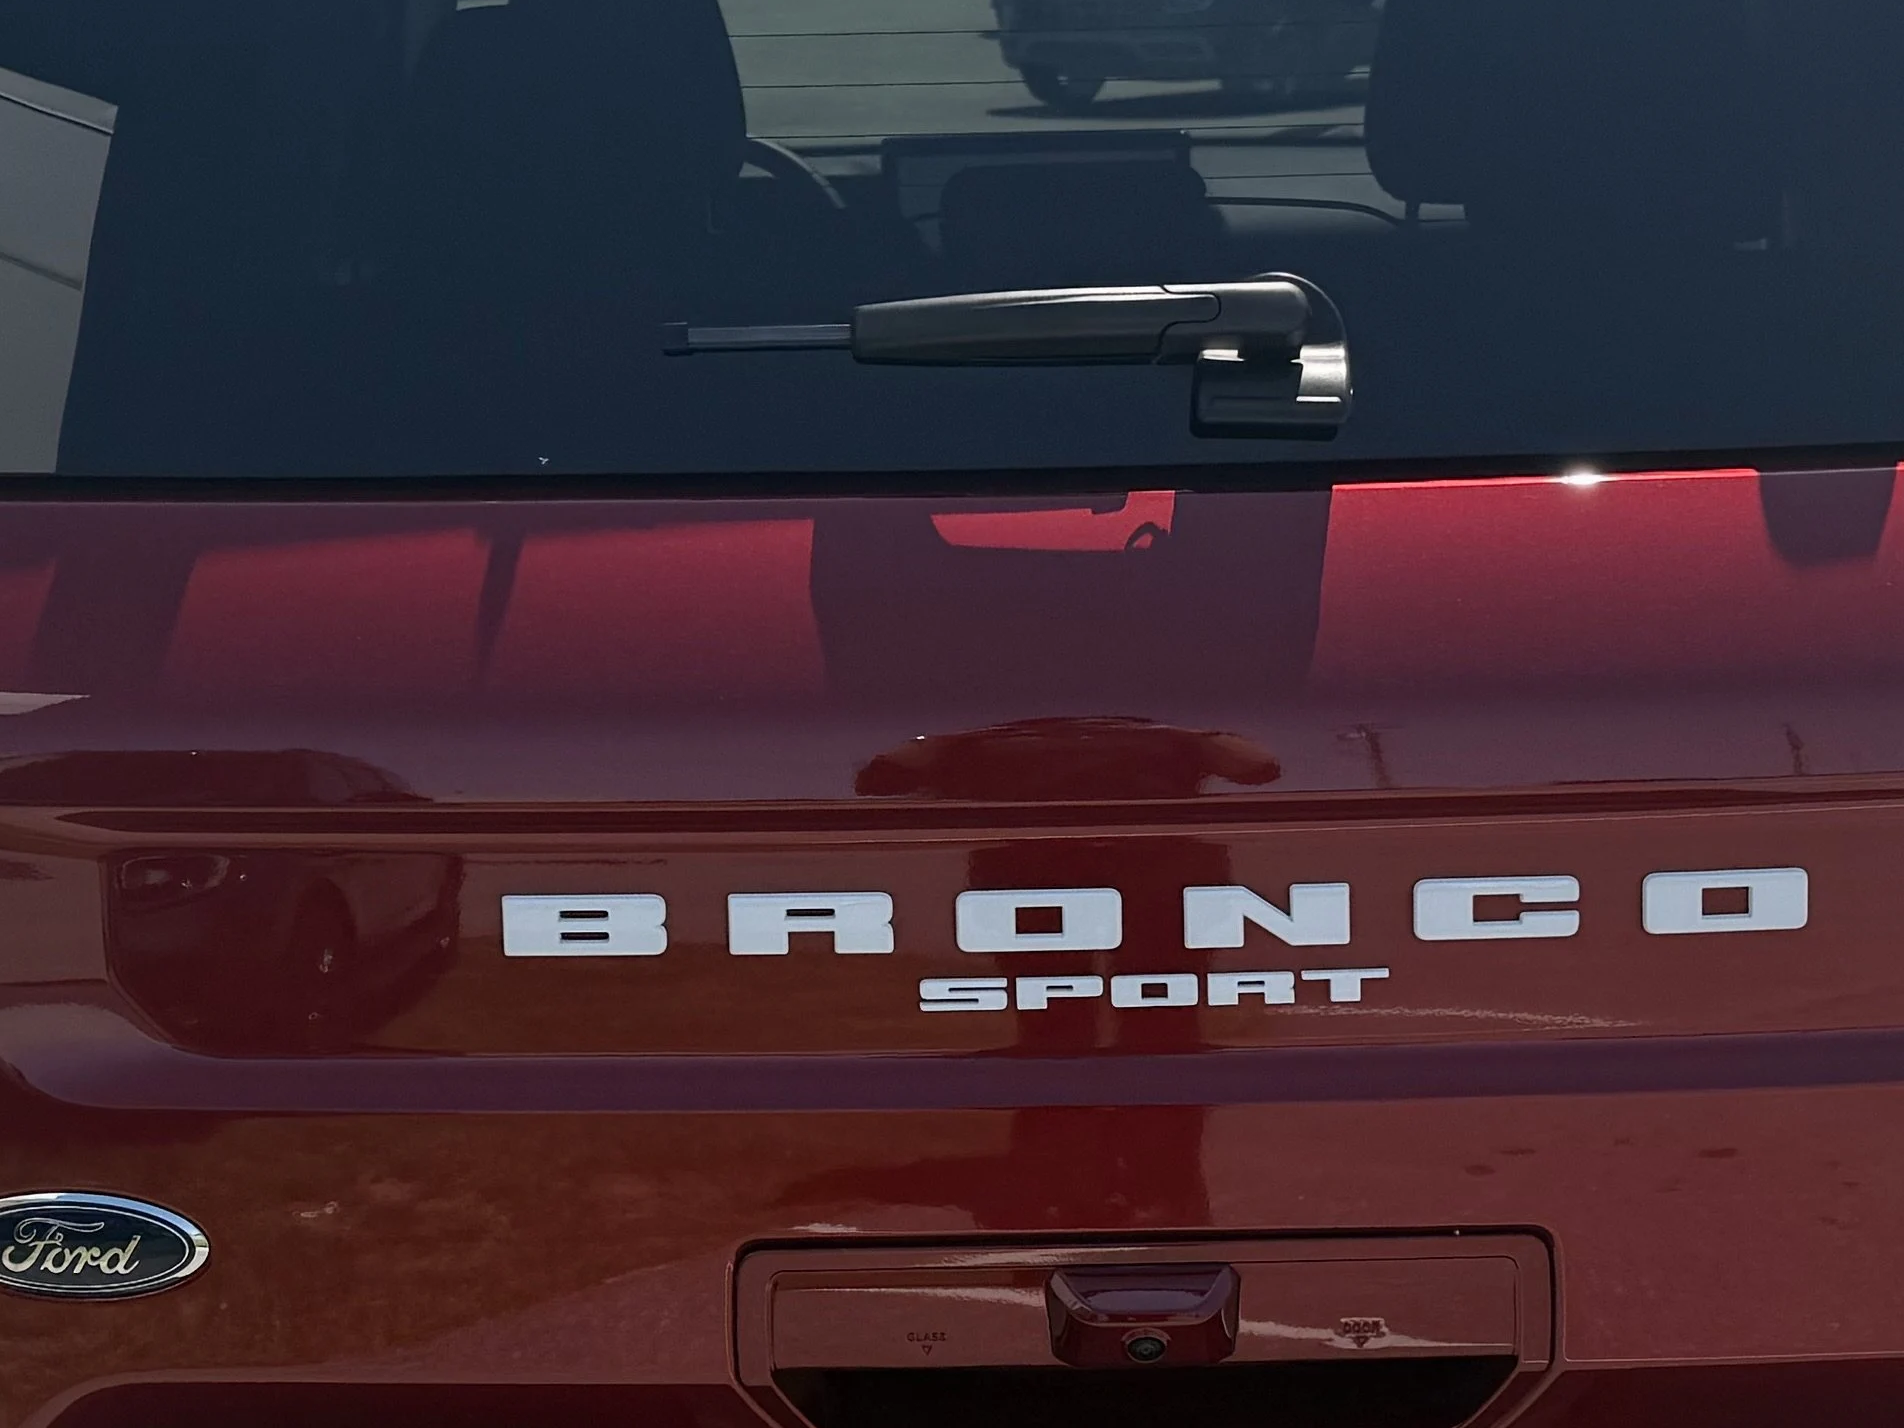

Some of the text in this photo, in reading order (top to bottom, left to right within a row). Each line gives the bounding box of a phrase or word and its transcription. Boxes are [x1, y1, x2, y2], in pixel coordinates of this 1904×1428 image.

[500, 866, 1809, 958] BRONCO
[918, 967, 1390, 1013] SPORT
[1, 1216, 142, 1275] Ford
[906, 1331, 946, 1342] GLASS
